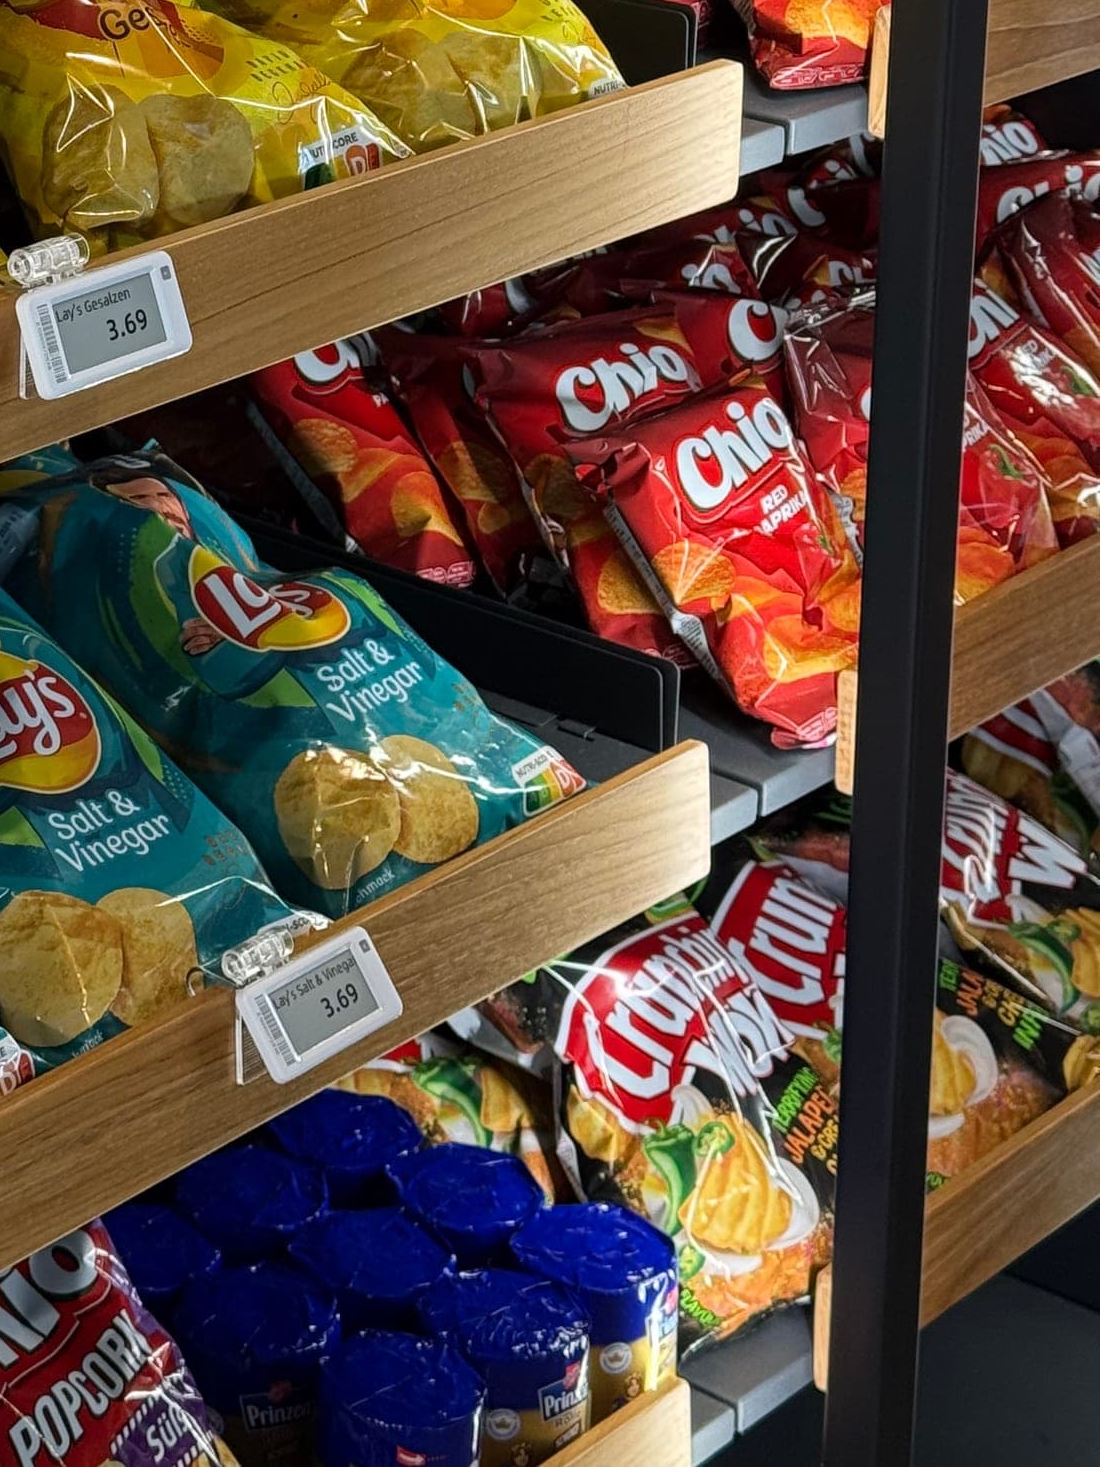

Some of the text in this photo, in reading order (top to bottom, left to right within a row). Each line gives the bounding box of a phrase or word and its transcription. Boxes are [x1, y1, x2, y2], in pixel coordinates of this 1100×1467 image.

[55, 288, 131, 324] Lay's Gesalzen
[106, 308, 148, 341] 3.69
[555, 342, 689, 432] Chio
[676, 397, 792, 510] Chio
[316, 638, 396, 693] Salt &
[326, 656, 423, 723] Vinegar
[47, 788, 141, 842] Salt &
[55, 810, 170, 875] Vinegar
[296, 978, 316, 996] Salt
[315, 973, 325, 986] &
[320, 982, 359, 1019] 3.69
[9, 1307, 154, 1467] POPCORN
